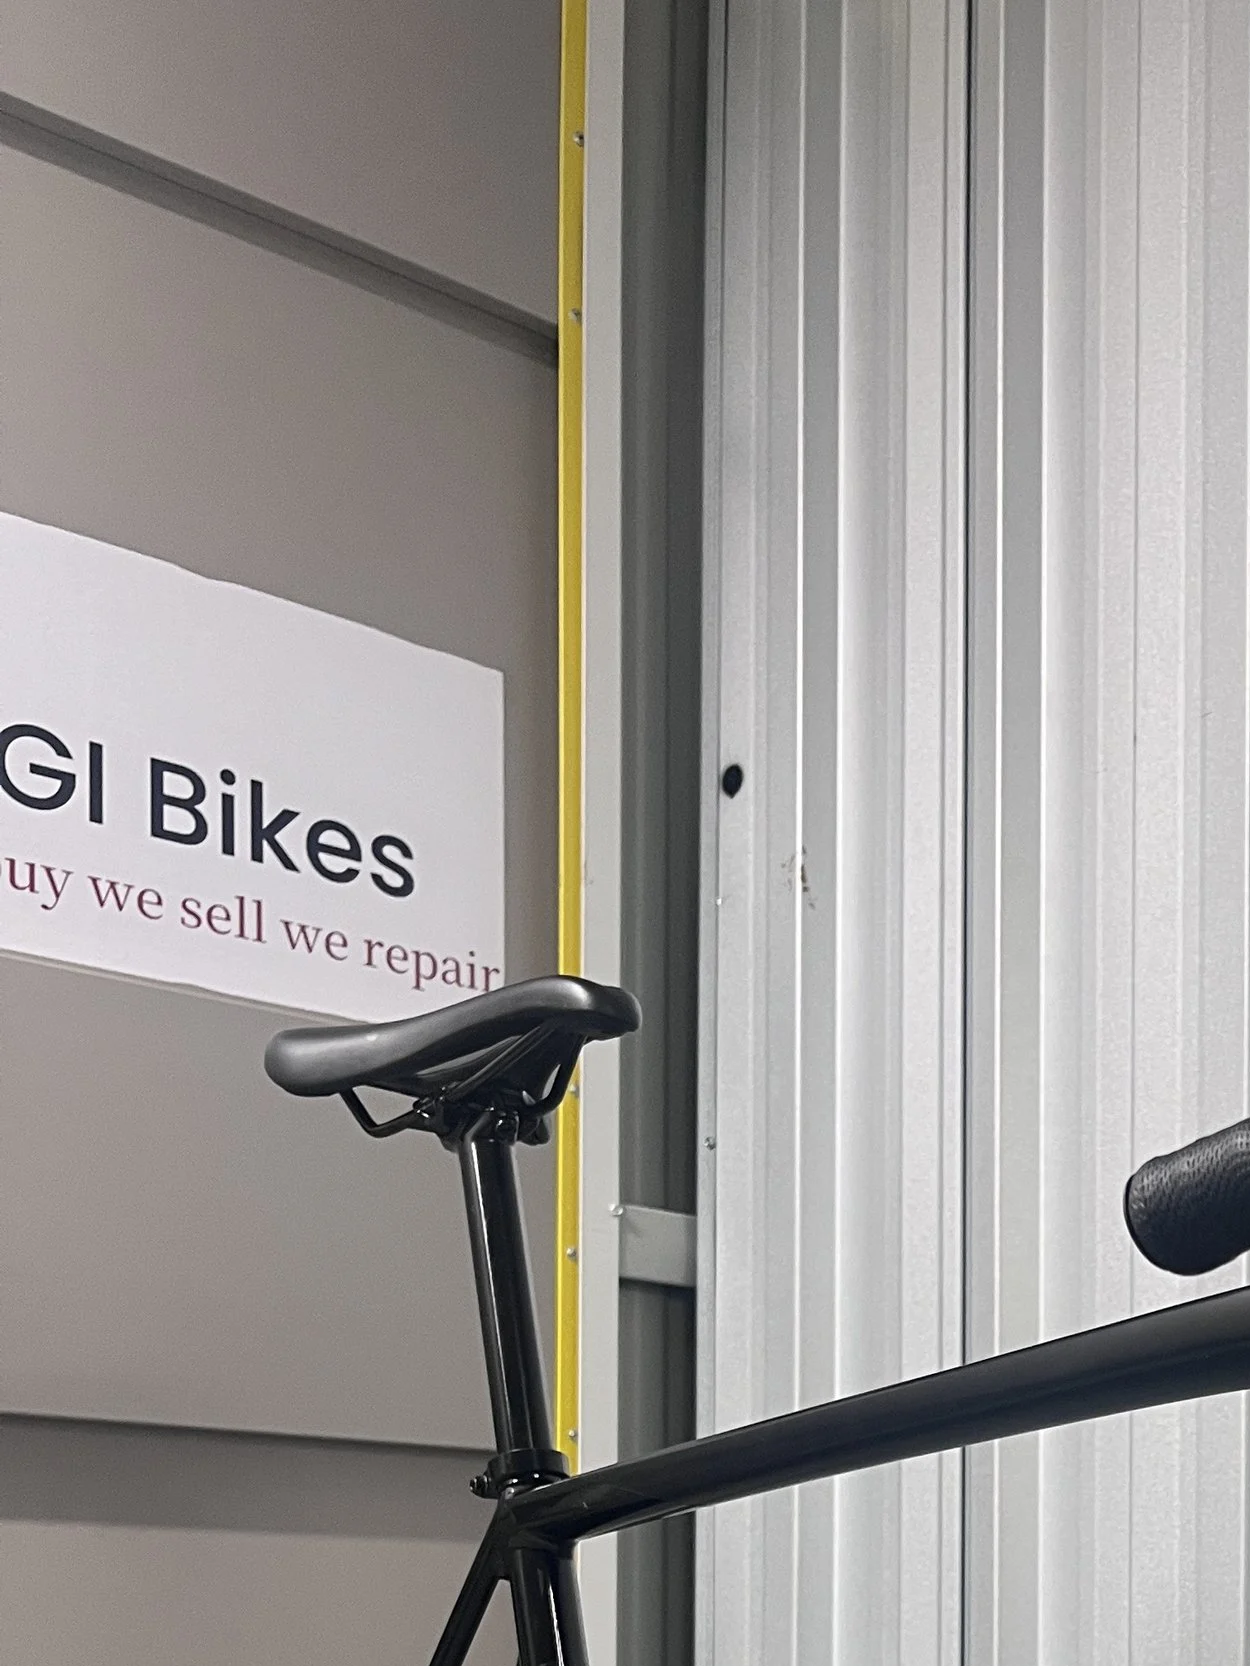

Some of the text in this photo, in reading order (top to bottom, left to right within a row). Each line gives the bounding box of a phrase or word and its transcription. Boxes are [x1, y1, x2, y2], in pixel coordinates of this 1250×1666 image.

[0, 723, 415, 898] GI Bikes
[0, 856, 501, 993] uy we sell we repair
